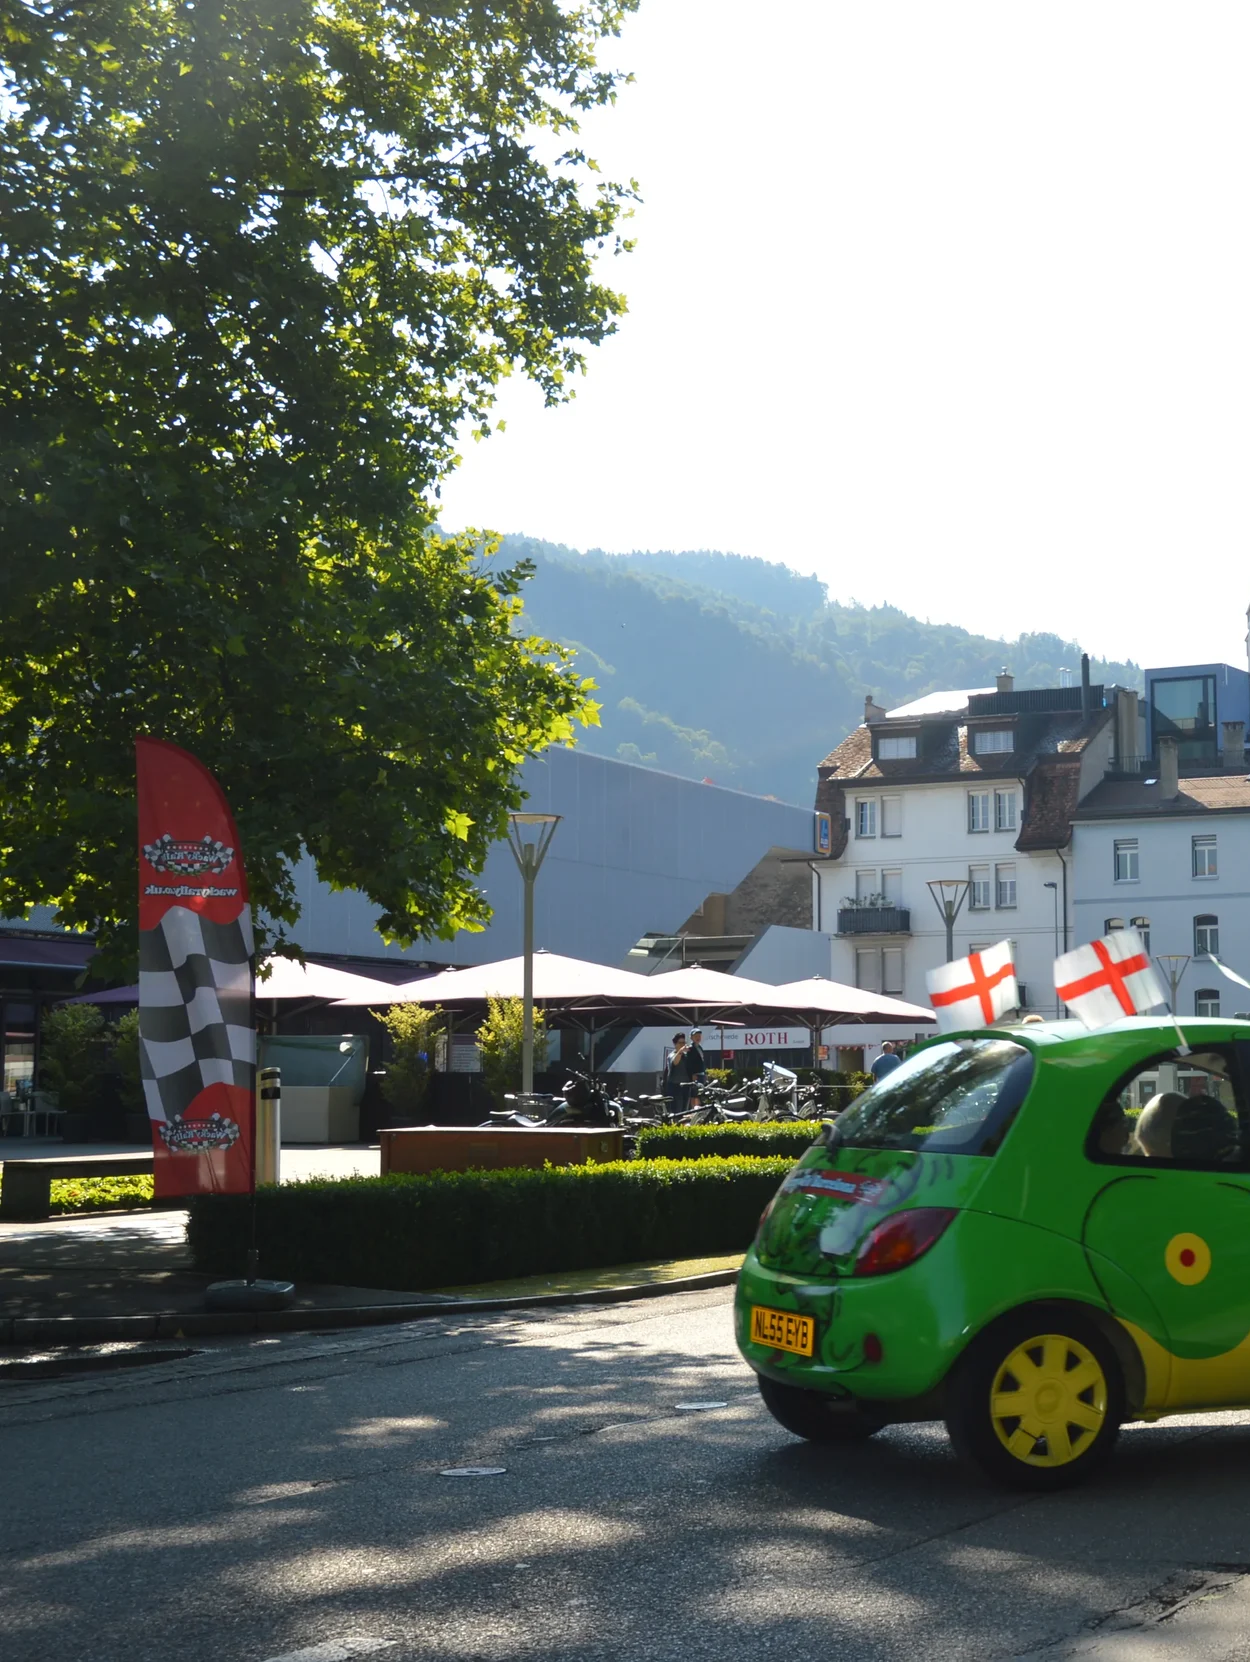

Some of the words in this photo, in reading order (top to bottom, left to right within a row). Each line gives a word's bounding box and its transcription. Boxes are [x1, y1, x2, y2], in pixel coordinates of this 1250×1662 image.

[744, 1032, 788, 1045] ROTH
[755, 1310, 783, 1344] NL55
[786, 1316, 809, 1349] EYB
